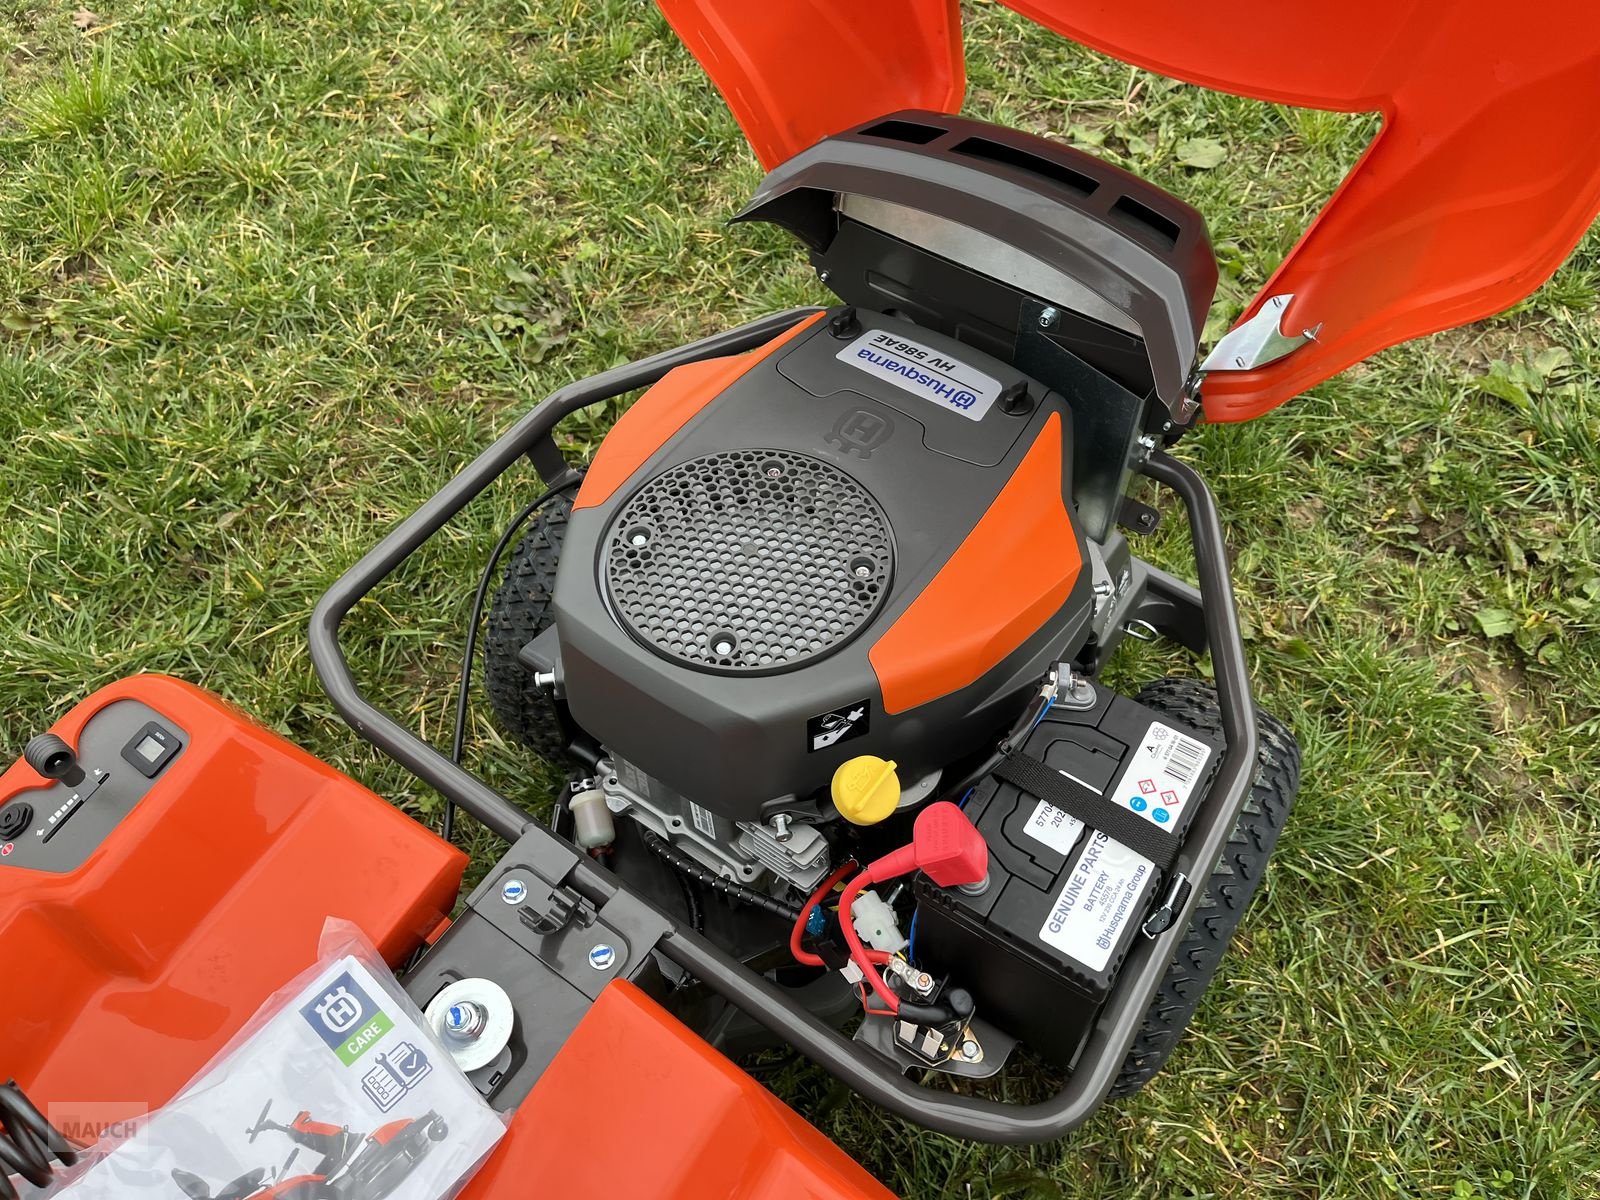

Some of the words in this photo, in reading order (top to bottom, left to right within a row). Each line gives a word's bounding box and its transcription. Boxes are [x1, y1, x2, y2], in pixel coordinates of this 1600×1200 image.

[873, 334, 929, 360] 586AE
[857, 348, 956, 400] Husqvarna
[928, 357, 956, 372] HV
[1050, 807, 1067, 828] 202
[1048, 873, 1087, 934] GENUINE
[1080, 831, 1109, 874] PARTS
[1083, 870, 1110, 912] BATTERY
[1098, 886, 1113, 906] 45578
[1102, 890, 1133, 940] Husqvarna
[1127, 864, 1146, 891] Group
[347, 1021, 382, 1055] CARE
